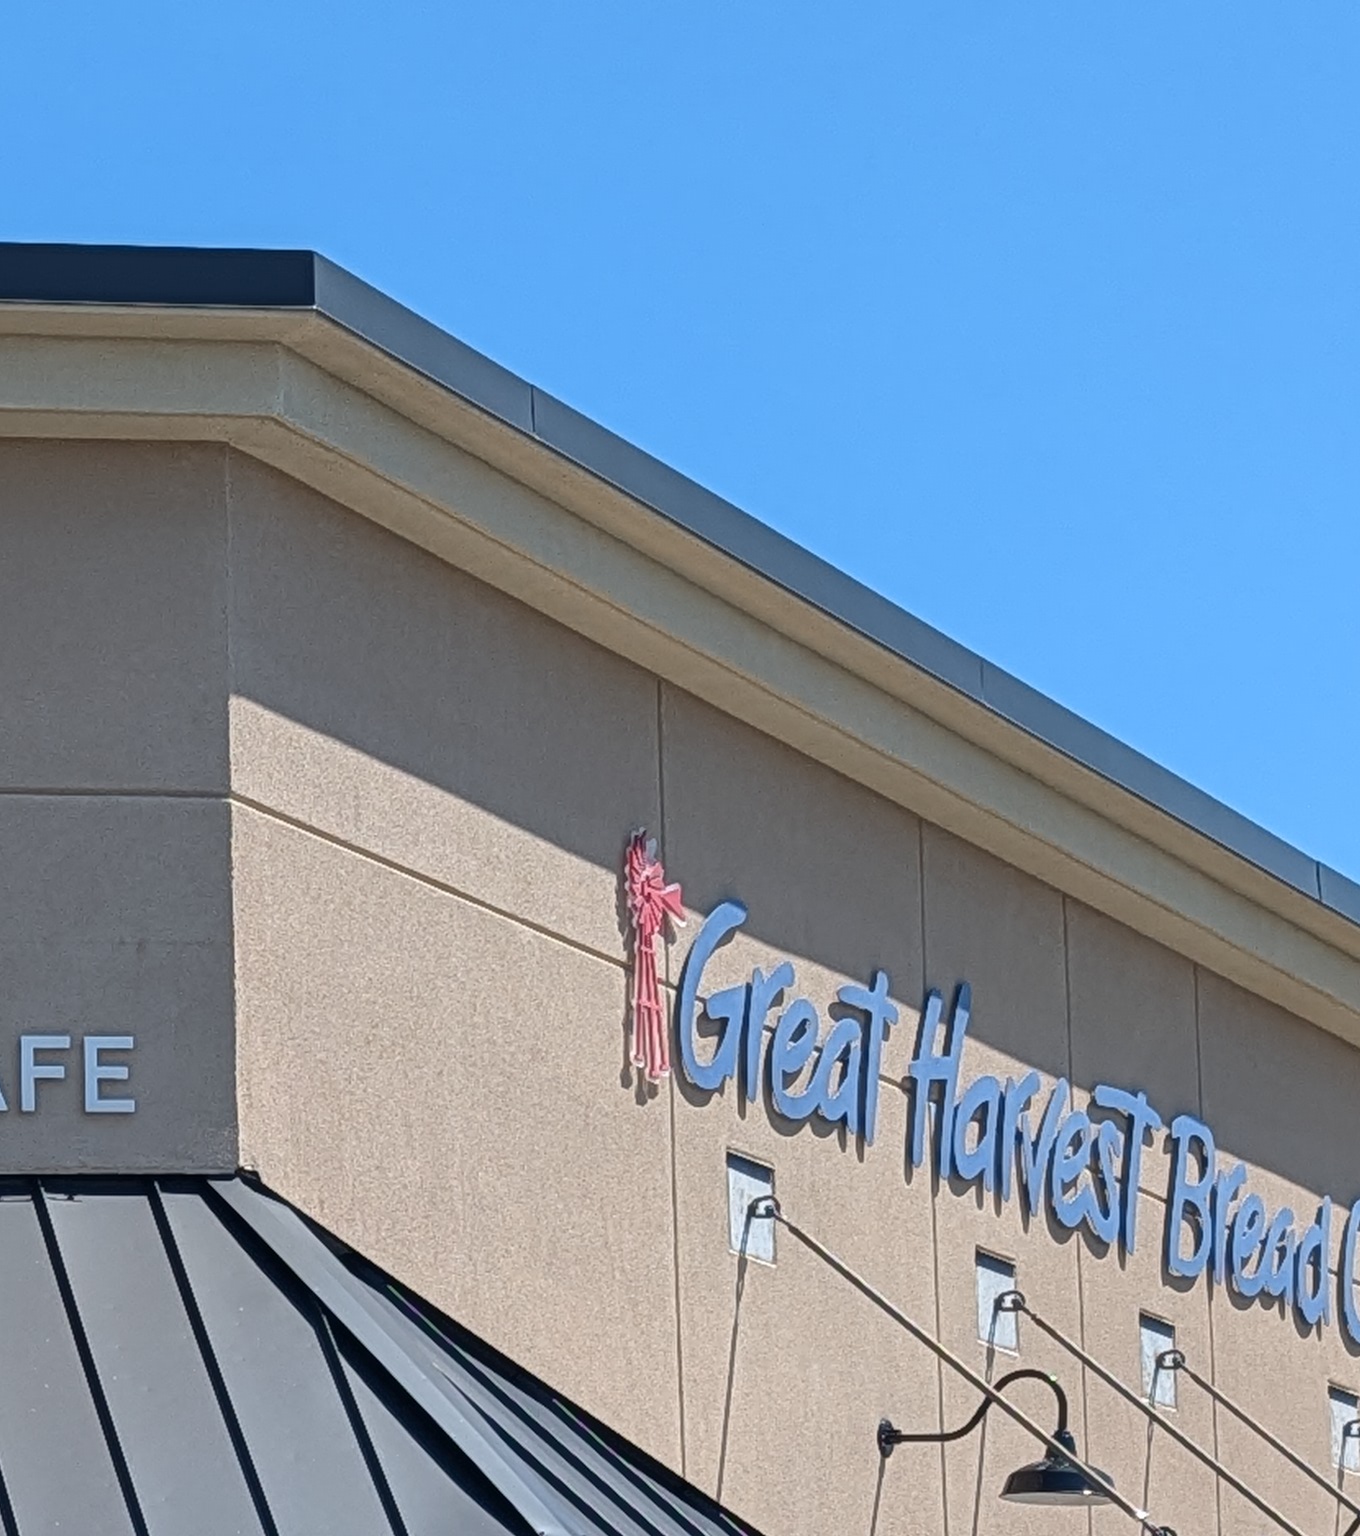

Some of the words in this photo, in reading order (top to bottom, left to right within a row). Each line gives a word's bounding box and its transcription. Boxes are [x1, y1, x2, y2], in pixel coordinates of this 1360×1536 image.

[680, 902, 899, 1145] Great
[907, 982, 1161, 1255] Harvest
[1169, 1115, 1332, 1327] Bread
